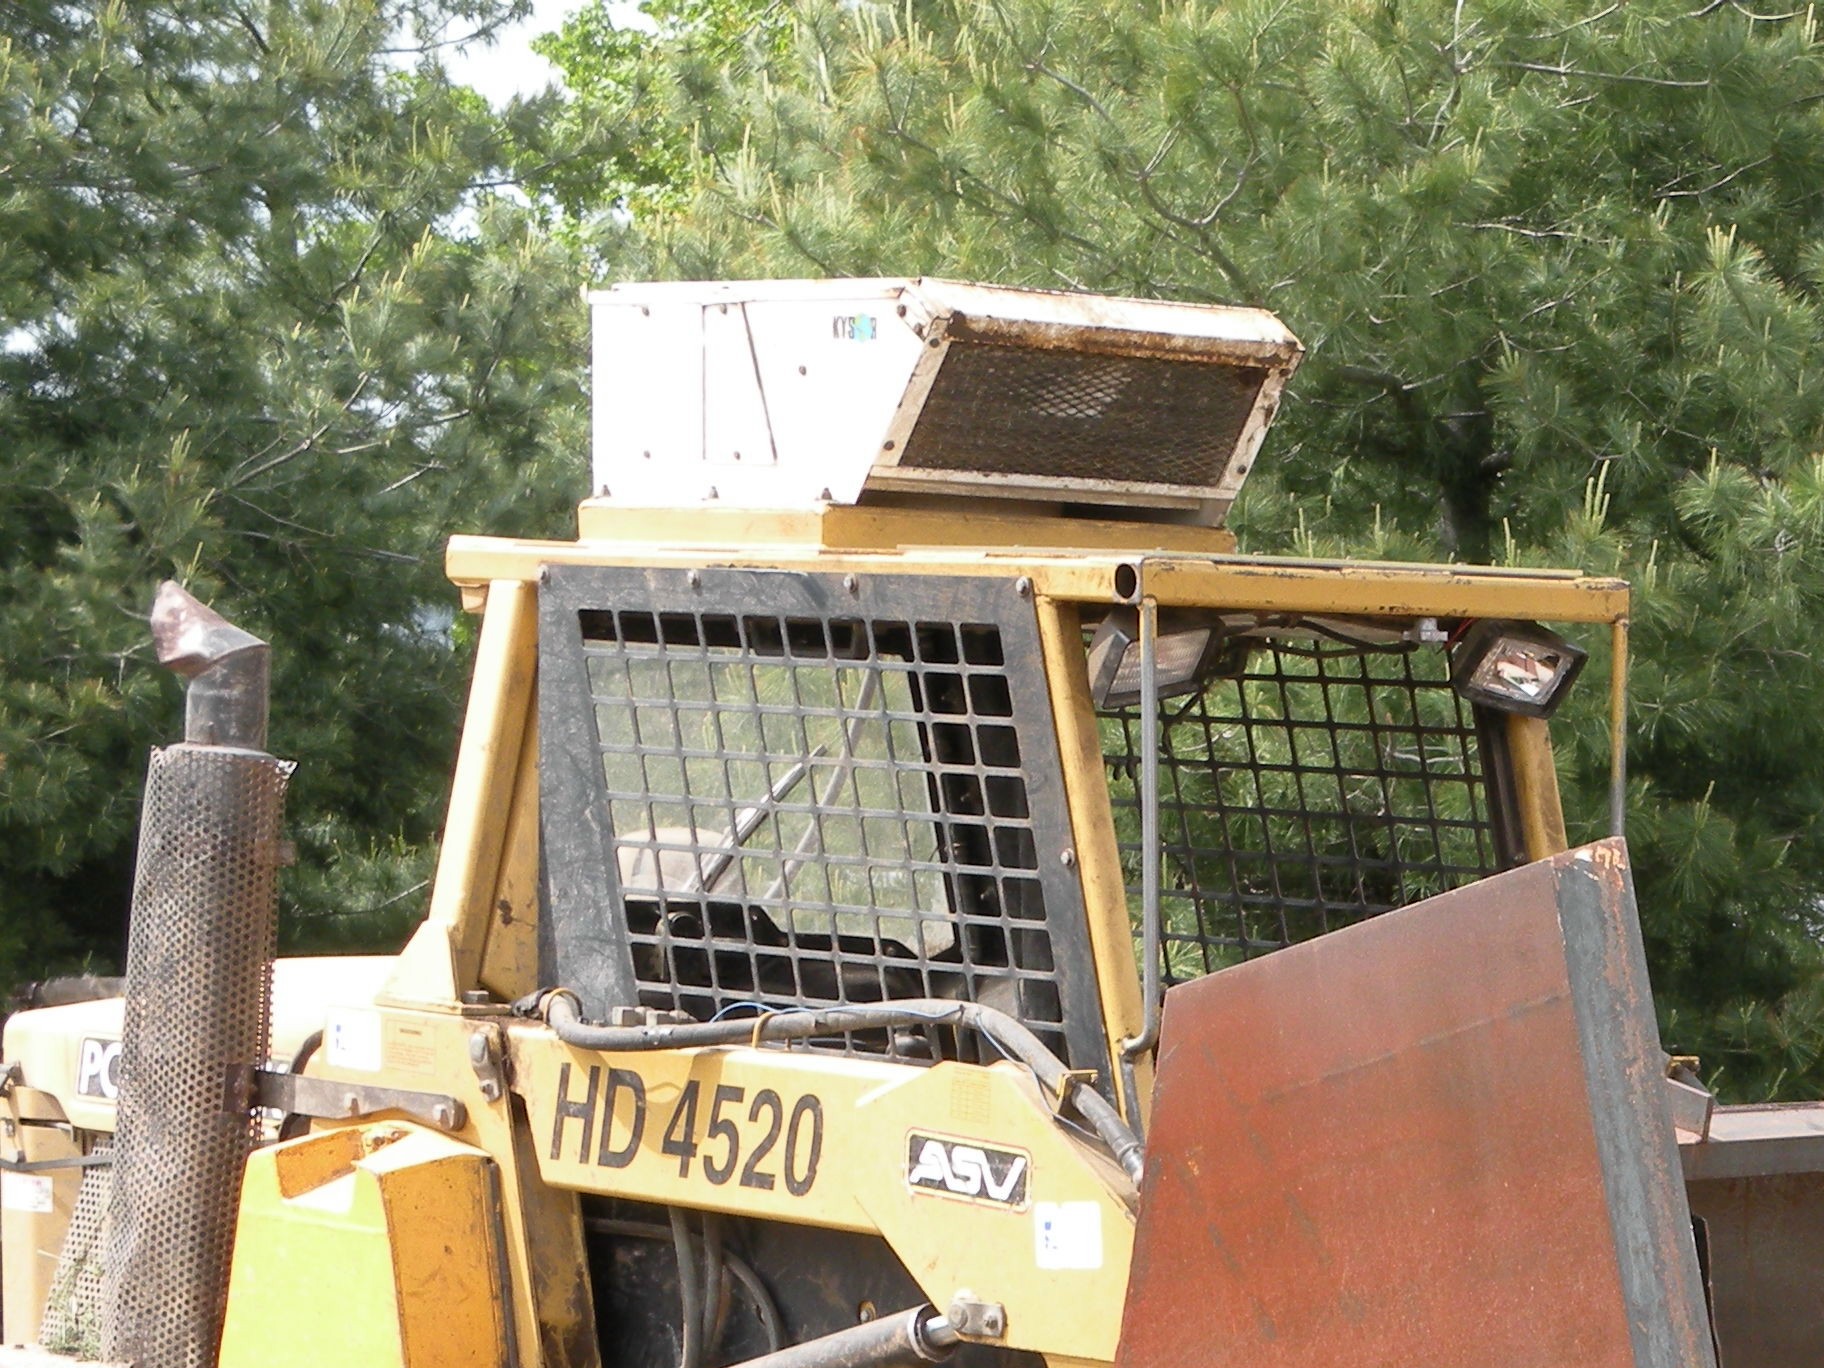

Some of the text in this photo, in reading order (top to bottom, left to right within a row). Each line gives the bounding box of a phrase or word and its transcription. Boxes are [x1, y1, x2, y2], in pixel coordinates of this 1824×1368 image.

[550, 1062, 647, 1169] HD
[661, 1080, 824, 1197] 4520
[909, 1139, 1027, 1200] ASV
